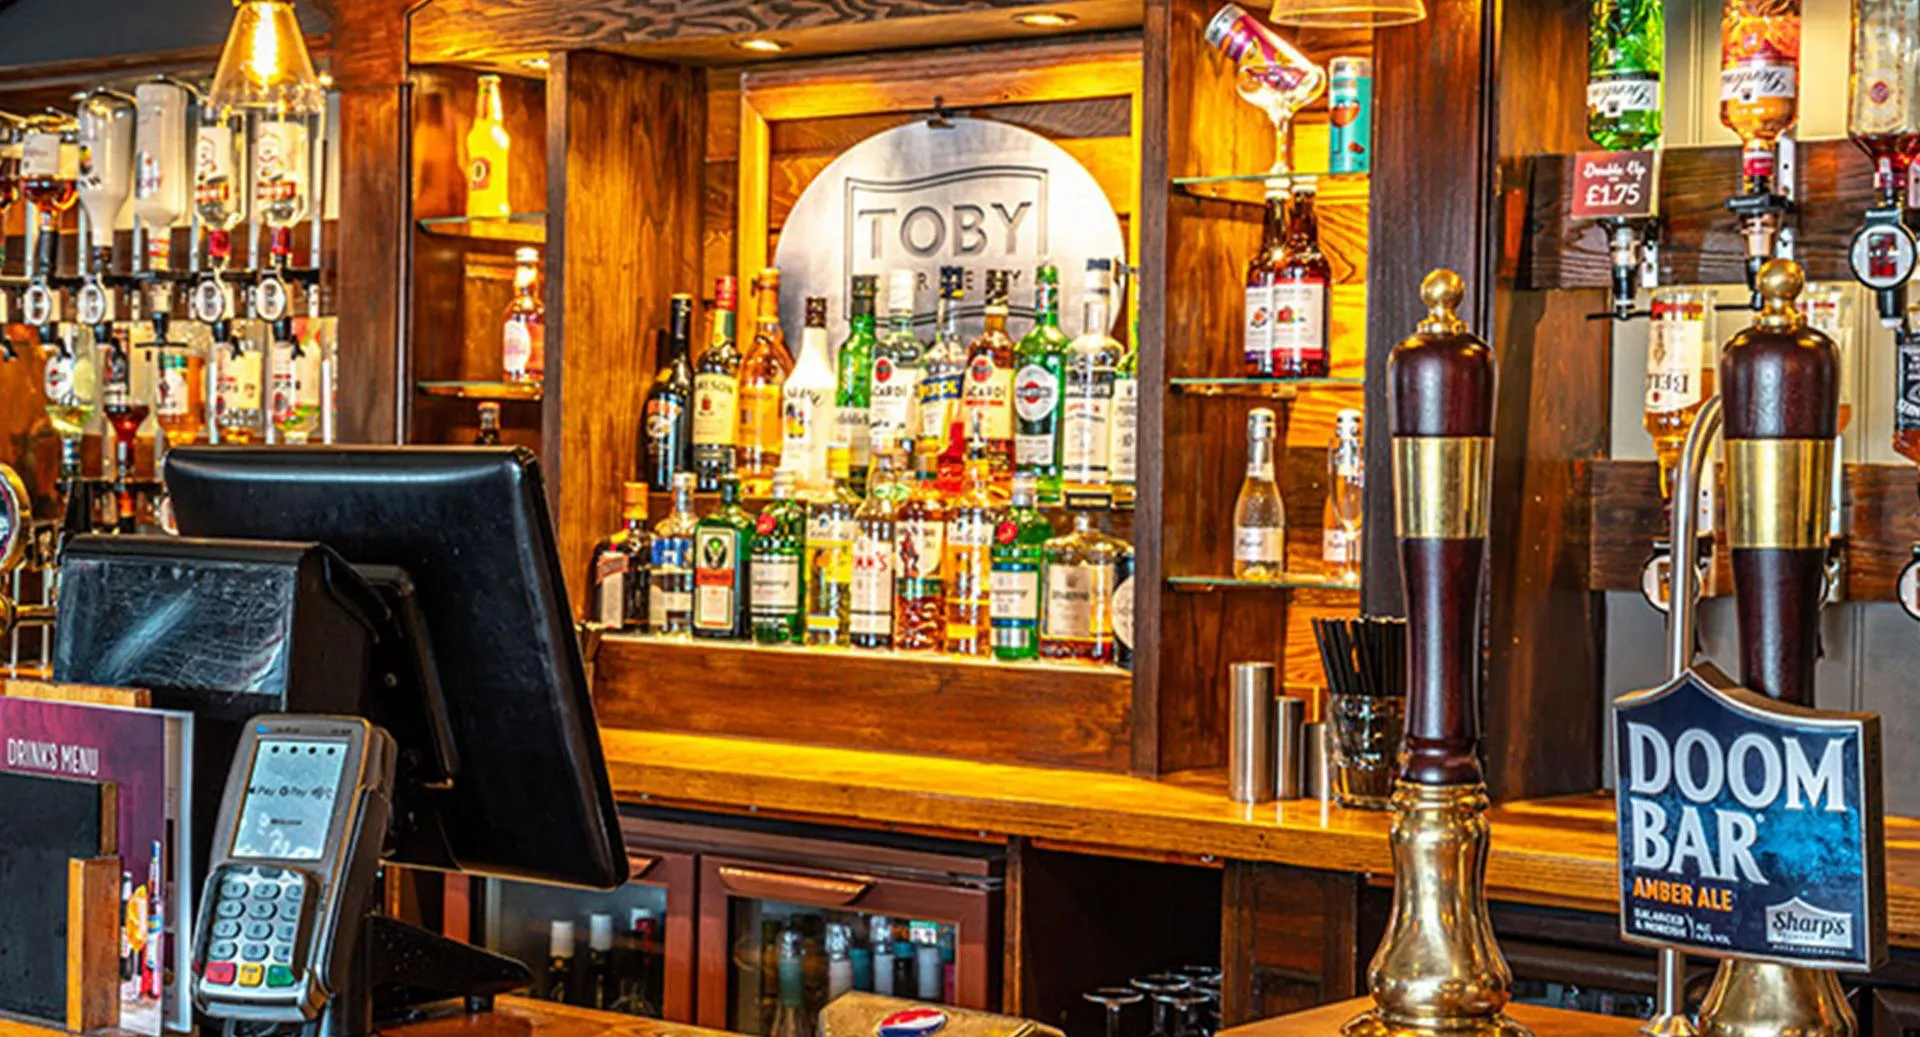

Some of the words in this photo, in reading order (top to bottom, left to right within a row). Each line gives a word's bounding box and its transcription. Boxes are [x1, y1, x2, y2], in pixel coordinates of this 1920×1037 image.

[1583, 162, 1624, 178] Double
[1584, 183, 1640, 206] £1.75
[859, 201, 1032, 260] TOBY
[7, 738, 58, 770] DRINKS
[60, 743, 99, 776] MENU
[1627, 722, 1849, 812] DOOM
[1631, 797, 1769, 885] BAR
[1633, 876, 1693, 908] AMBER
[1697, 886, 1733, 913] ALE
[1772, 911, 1846, 940] Sharp's
